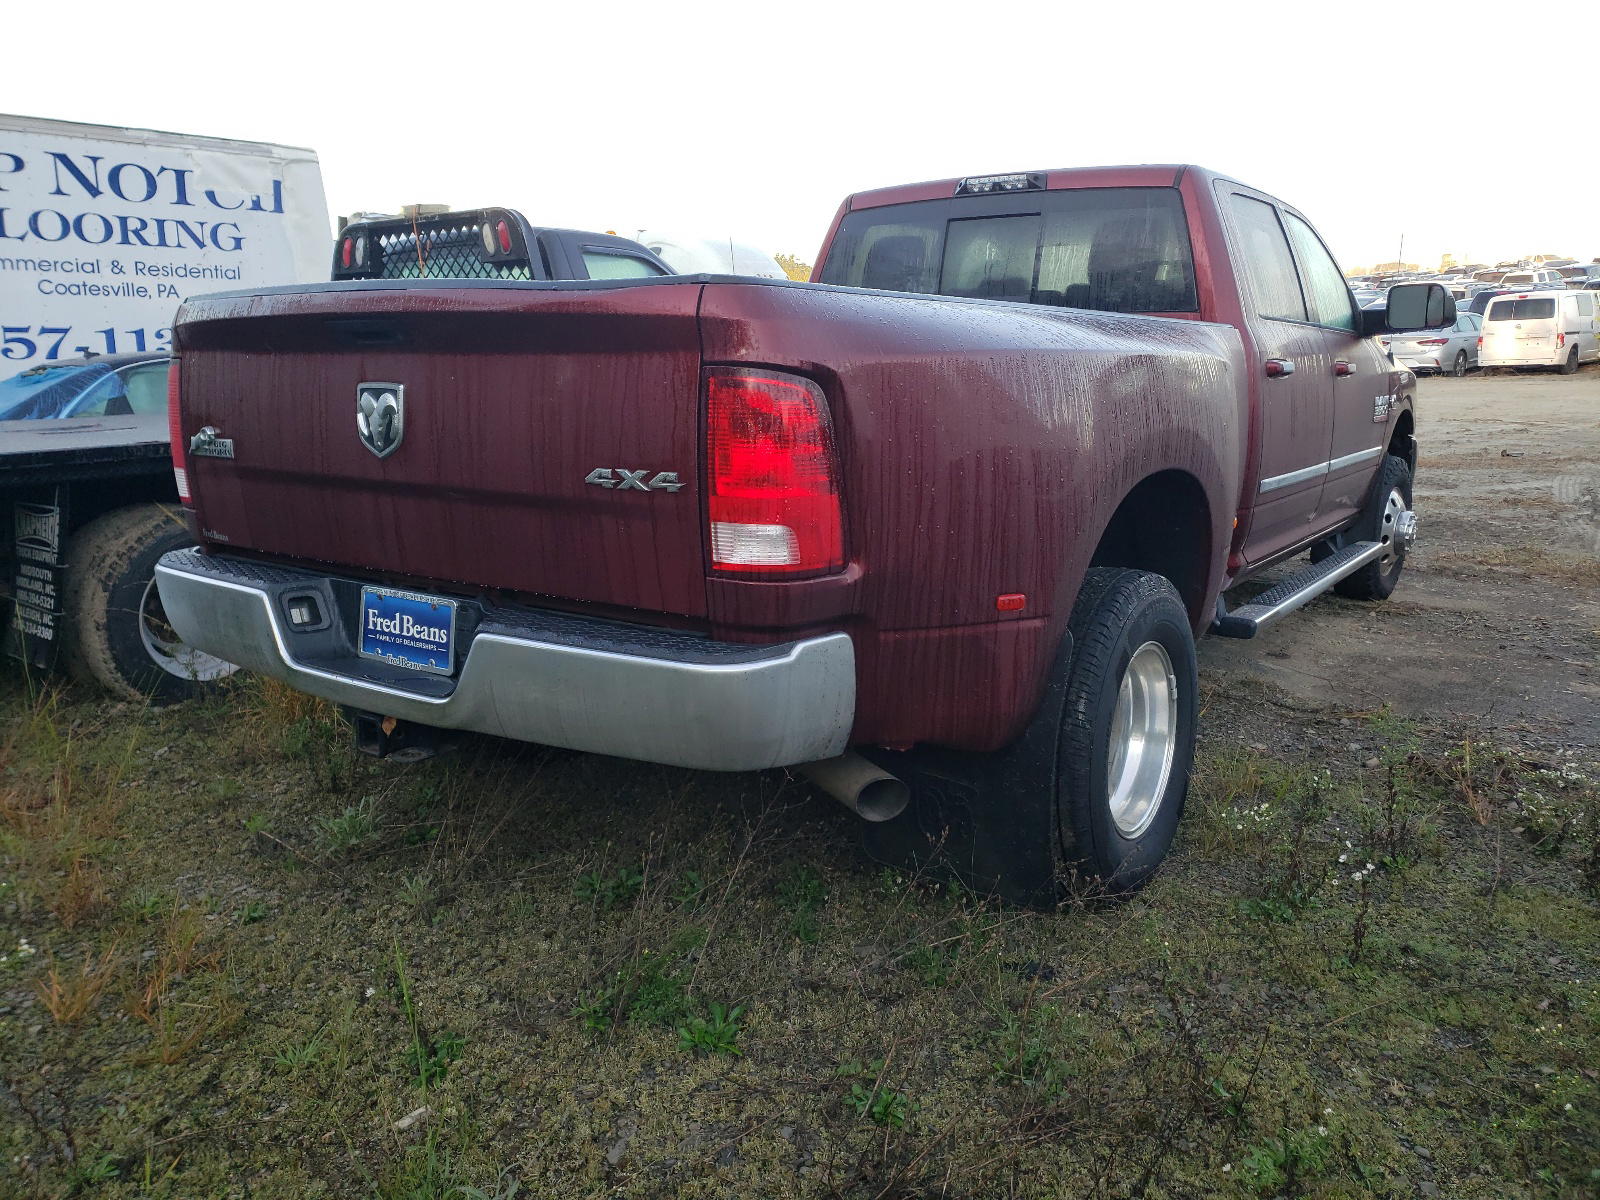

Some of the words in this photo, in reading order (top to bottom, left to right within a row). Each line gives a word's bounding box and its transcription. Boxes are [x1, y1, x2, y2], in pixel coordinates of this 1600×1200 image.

[111, 260, 126, 275] &
[135, 261, 241, 280] Residential
[38, 279, 152, 299] Coatesville,
[157, 283, 180, 298] PA
[585, 471, 687, 493] 4X4
[376, 633, 395, 643] FAMILY
[403, 639, 437, 651] DEALERSHIPS
